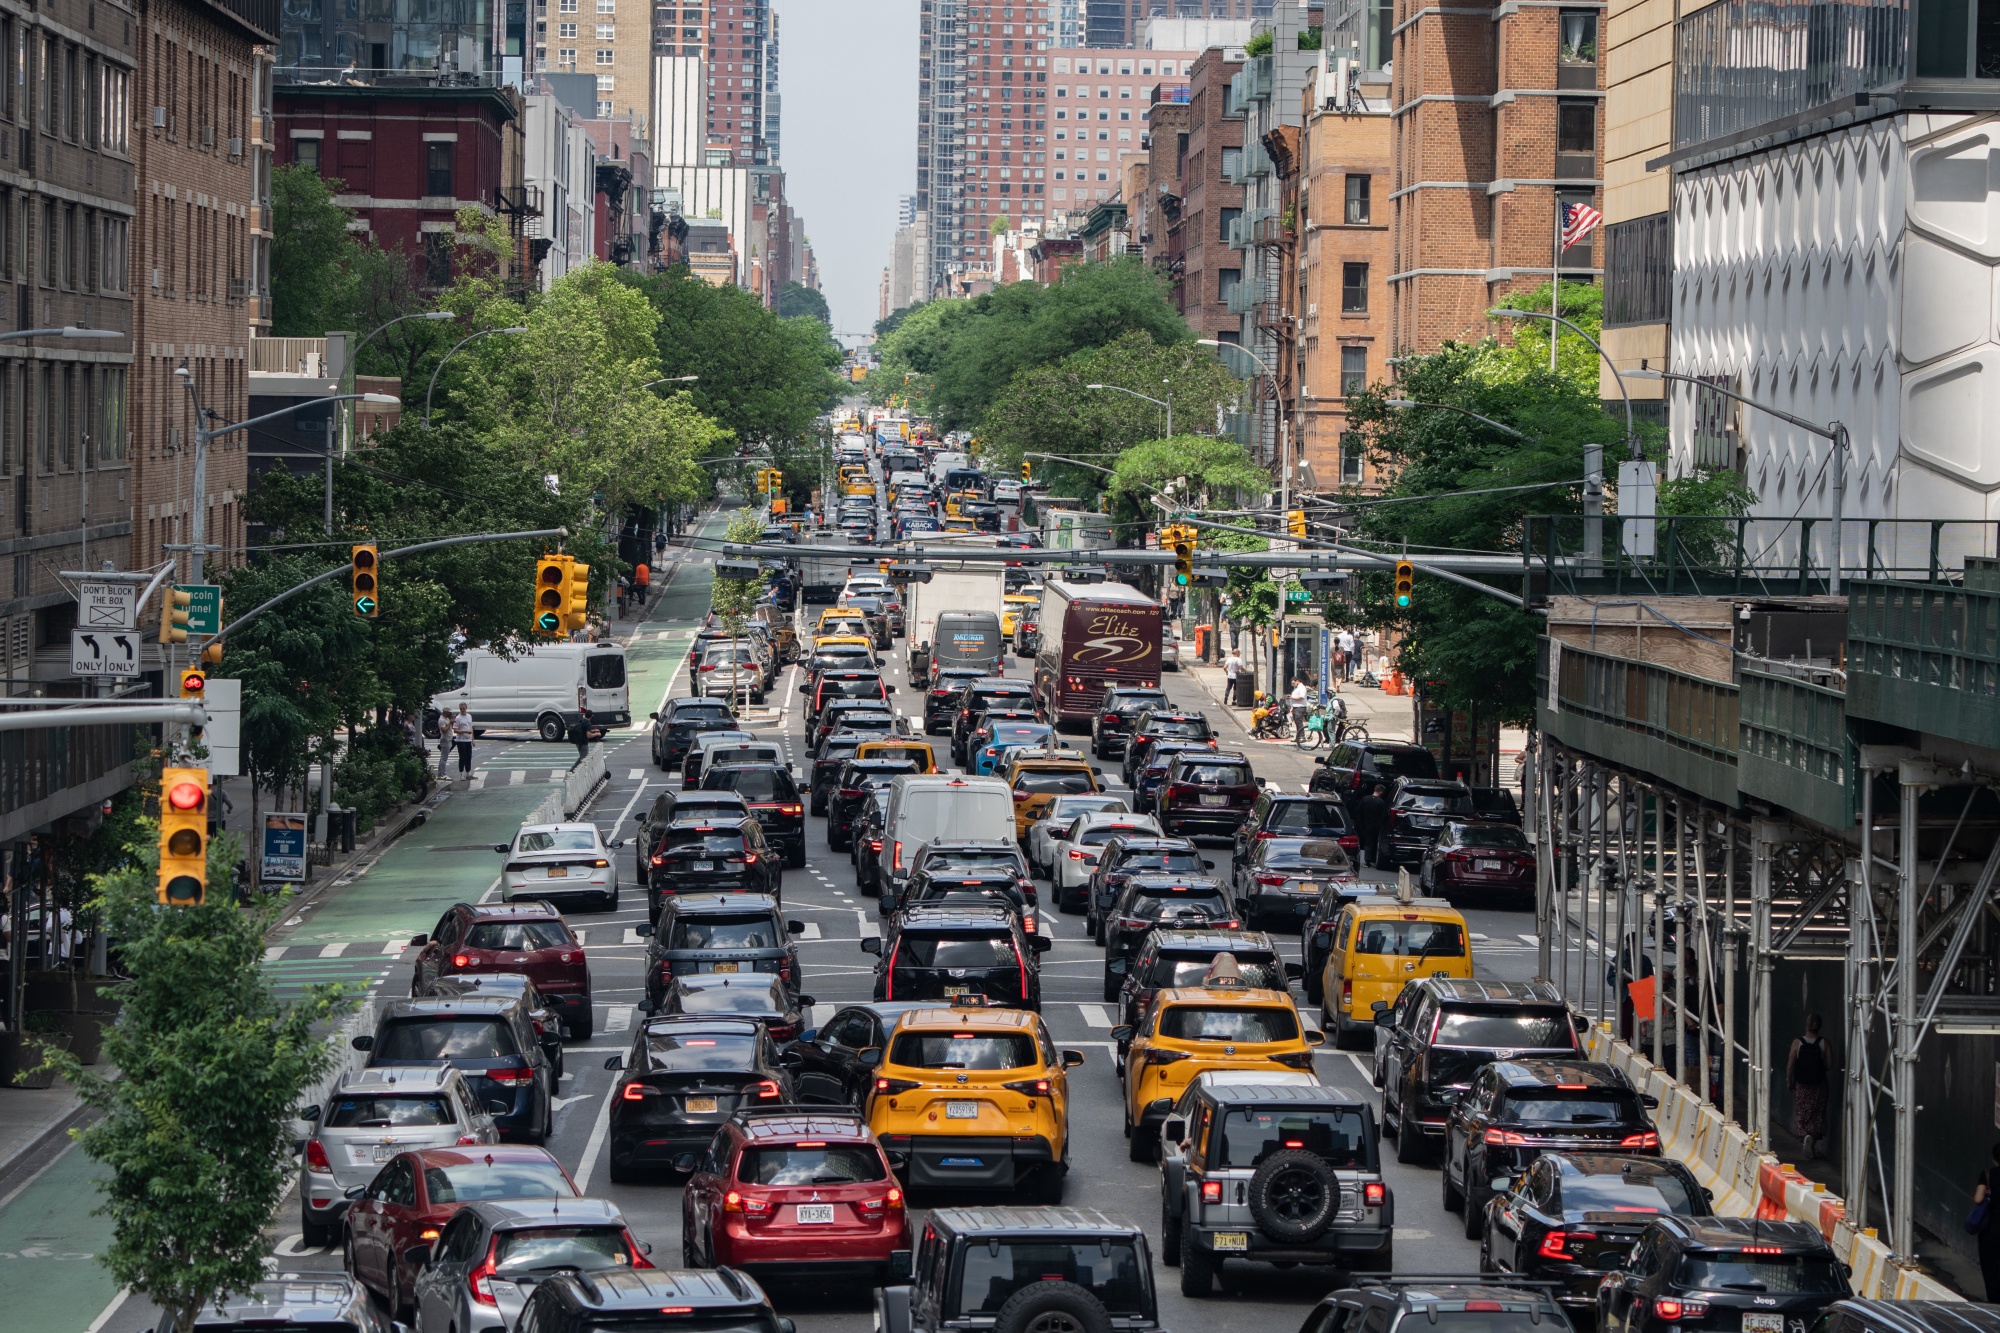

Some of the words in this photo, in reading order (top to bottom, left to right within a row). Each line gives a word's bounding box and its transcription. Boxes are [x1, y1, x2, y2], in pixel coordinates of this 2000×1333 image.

[1081, 531, 1110, 539] Heineken
[83, 586, 105, 595] DON'T
[108, 587, 133, 596] BLOCK
[92, 596, 106, 604] THE
[109, 597, 124, 605] BOX
[1085, 607, 1146, 615] www.elitecoach.com
[76, 661, 102, 671] ONLY
[109, 662, 135, 672] ONLY
[800, 1209, 831, 1219] KYA-3456
[1753, 1296, 1776, 1306] Jeep
